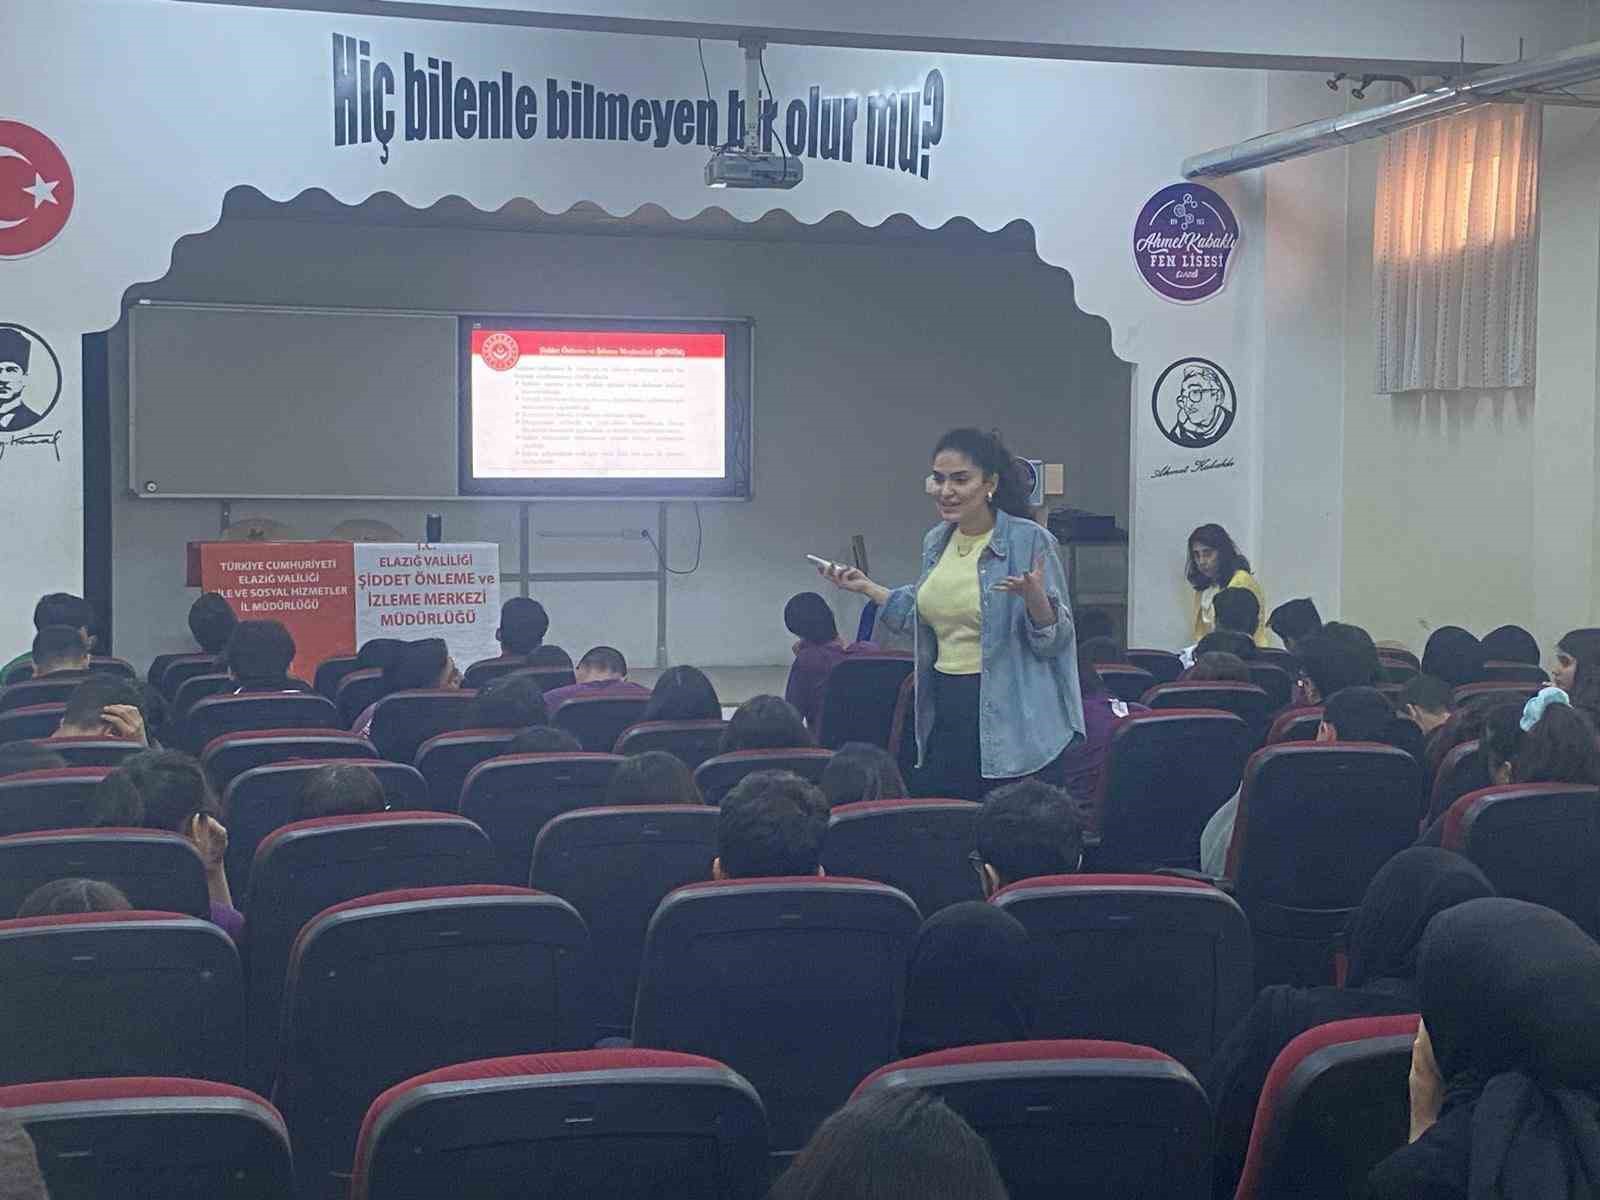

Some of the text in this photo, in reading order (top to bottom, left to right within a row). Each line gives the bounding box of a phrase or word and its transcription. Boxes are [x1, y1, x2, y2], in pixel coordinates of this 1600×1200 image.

[332, 32, 944, 180] Hiç bilenle bilmeyen br olur mu?
[1150, 255, 1177, 267] FEN
[220, 559, 337, 571] TÜRKİYE CUMHURİYETİ
[379, 553, 473, 568] ELAZIĞ VALİLİĞİ
[238, 572, 320, 585] ELAZIĞ VALİLİĞİ
[358, 570, 496, 591] ŞİDDET ÖNLEME ve
[235, 588, 249, 599] VE
[250, 586, 290, 599] SOSYAL
[367, 588, 487, 608] İZLEME MERKEZİ
[240, 599, 319, 613] İL MÜDÜRLÜĞÜ
[380, 609, 476, 627] MÜDÜRLÜĞÜ
